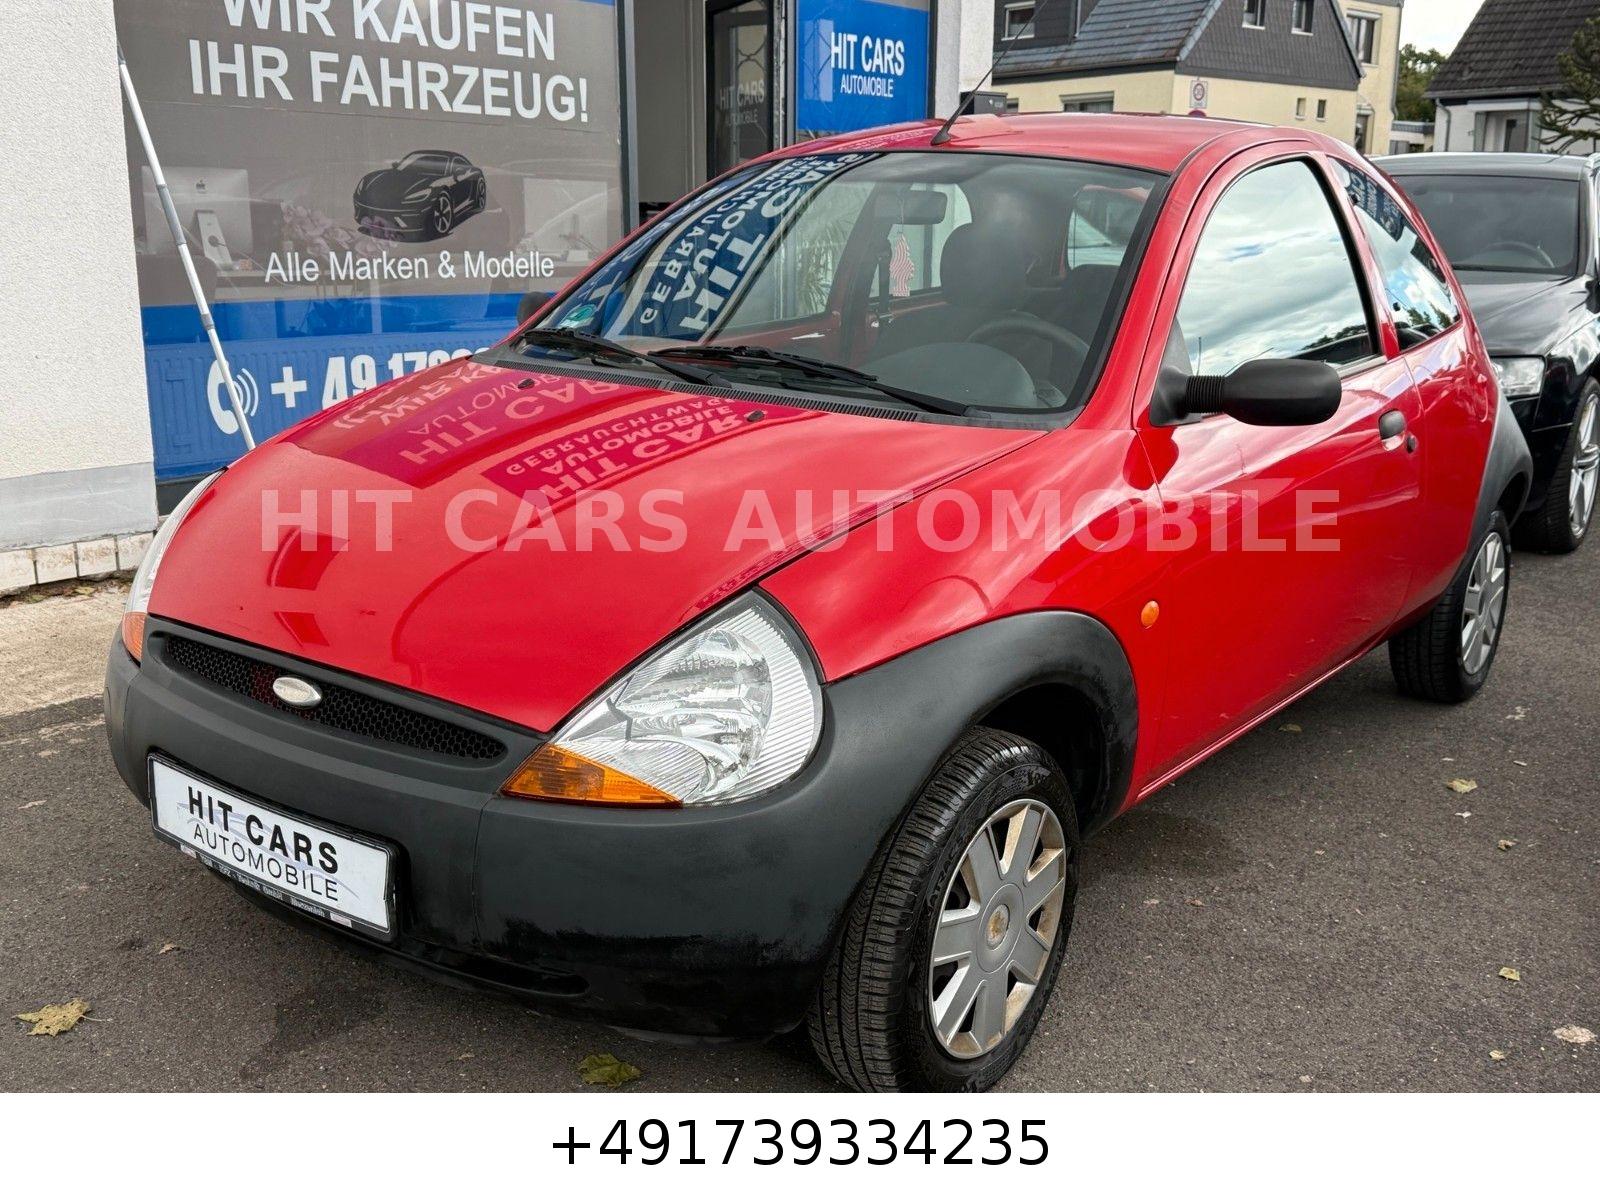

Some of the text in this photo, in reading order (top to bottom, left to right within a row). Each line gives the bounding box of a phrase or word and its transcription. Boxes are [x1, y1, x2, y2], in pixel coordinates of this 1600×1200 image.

[223, 0, 555, 61] WIR KAUFEN
[830, 32, 905, 76] HIT CARS
[189, 39, 588, 123] IHR FAHRZEUG!
[840, 75, 894, 98] AUTOMOBILE
[265, 250, 554, 283] Alle Marken & Modelle
[188, 786, 339, 875] HIT CARS
[193, 823, 339, 902] AUTOMOBILE
